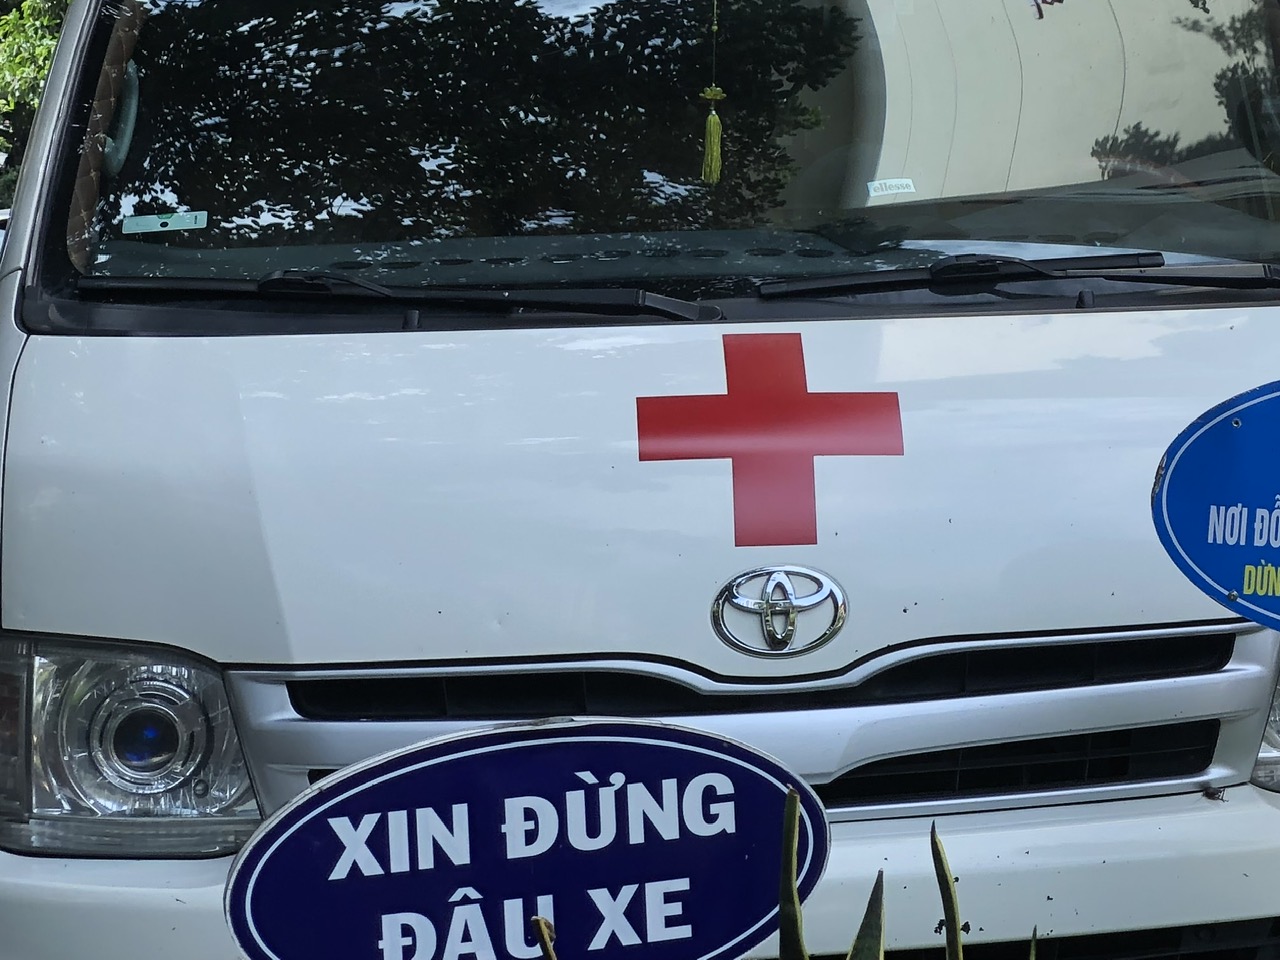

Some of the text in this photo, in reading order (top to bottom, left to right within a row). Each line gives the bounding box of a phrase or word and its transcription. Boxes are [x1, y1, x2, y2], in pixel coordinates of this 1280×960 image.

[873, 182, 912, 193] ellesse
[1207, 503, 1248, 546] NƠI
[327, 770, 736, 881] XIN ĐỪNG
[586, 877, 692, 951] XE
